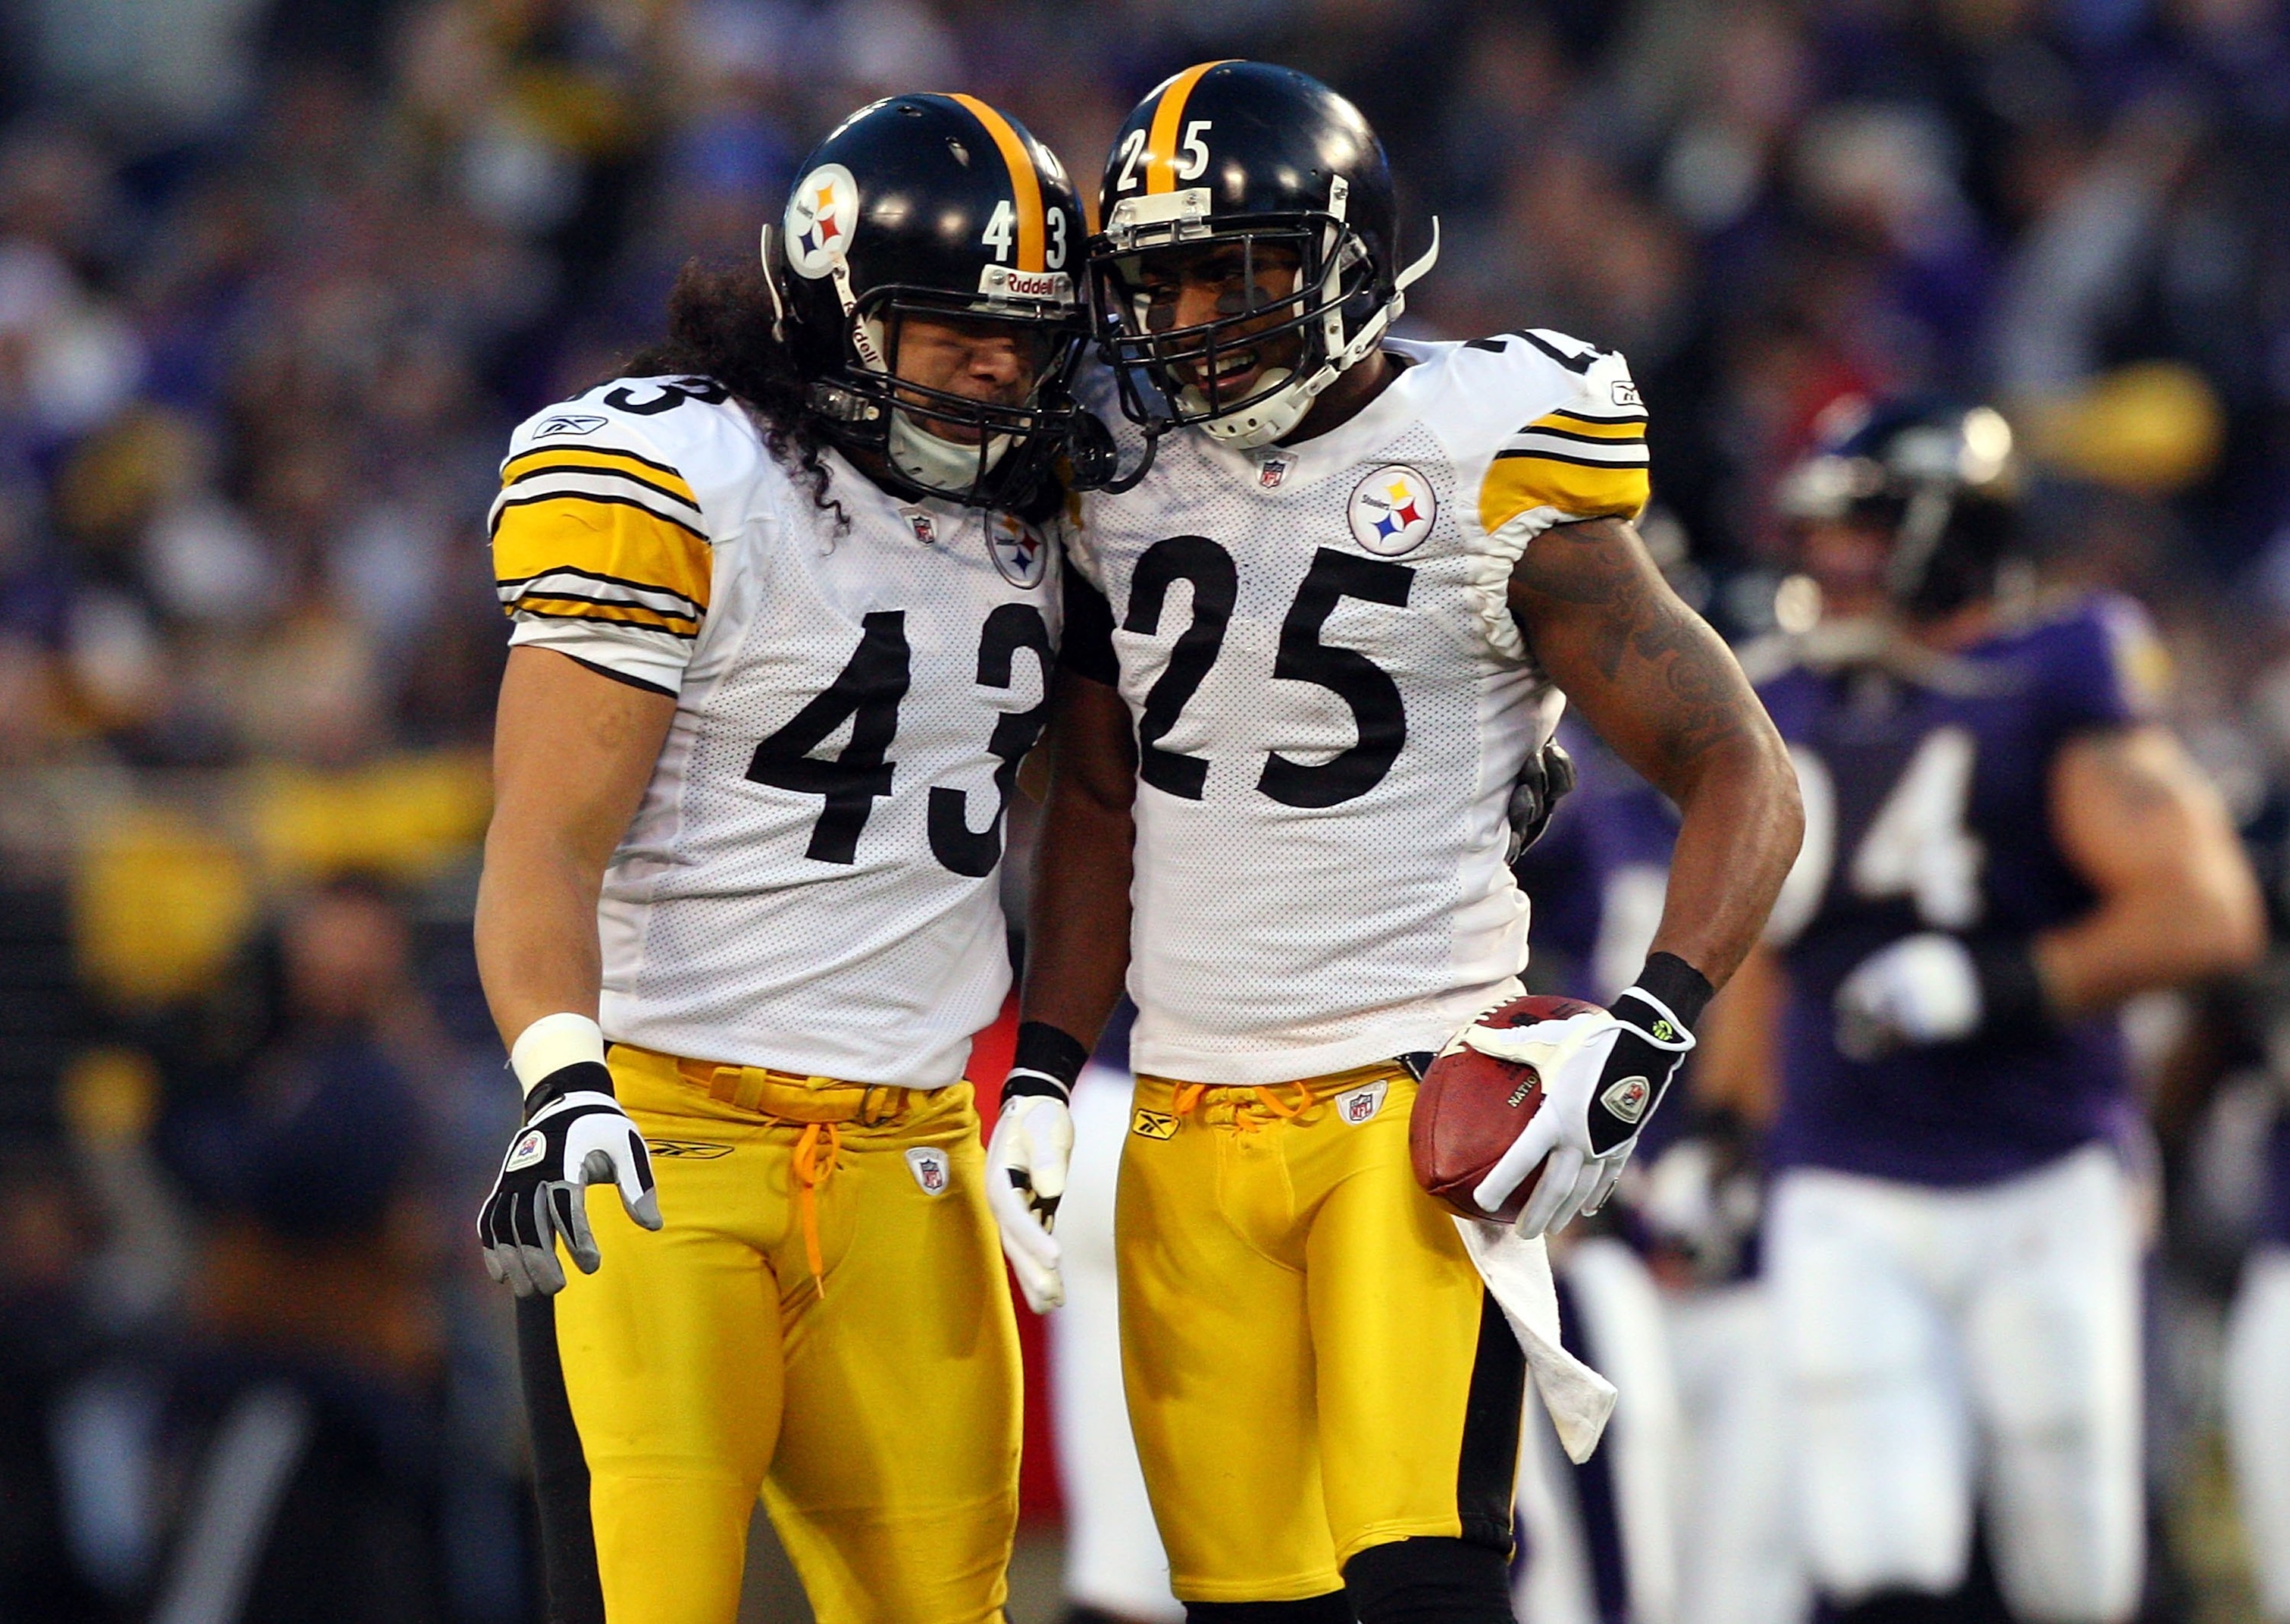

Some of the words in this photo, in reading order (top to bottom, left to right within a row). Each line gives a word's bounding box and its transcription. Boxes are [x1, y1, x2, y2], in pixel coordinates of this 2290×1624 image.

[1117, 120, 1212, 191] 25
[982, 200, 1067, 270] 43
[1007, 273, 1055, 295] Riddell
[1122, 535, 1416, 808] 25
[745, 603, 1053, 877] 43
[1350, 1101, 1372, 1119] NFL
